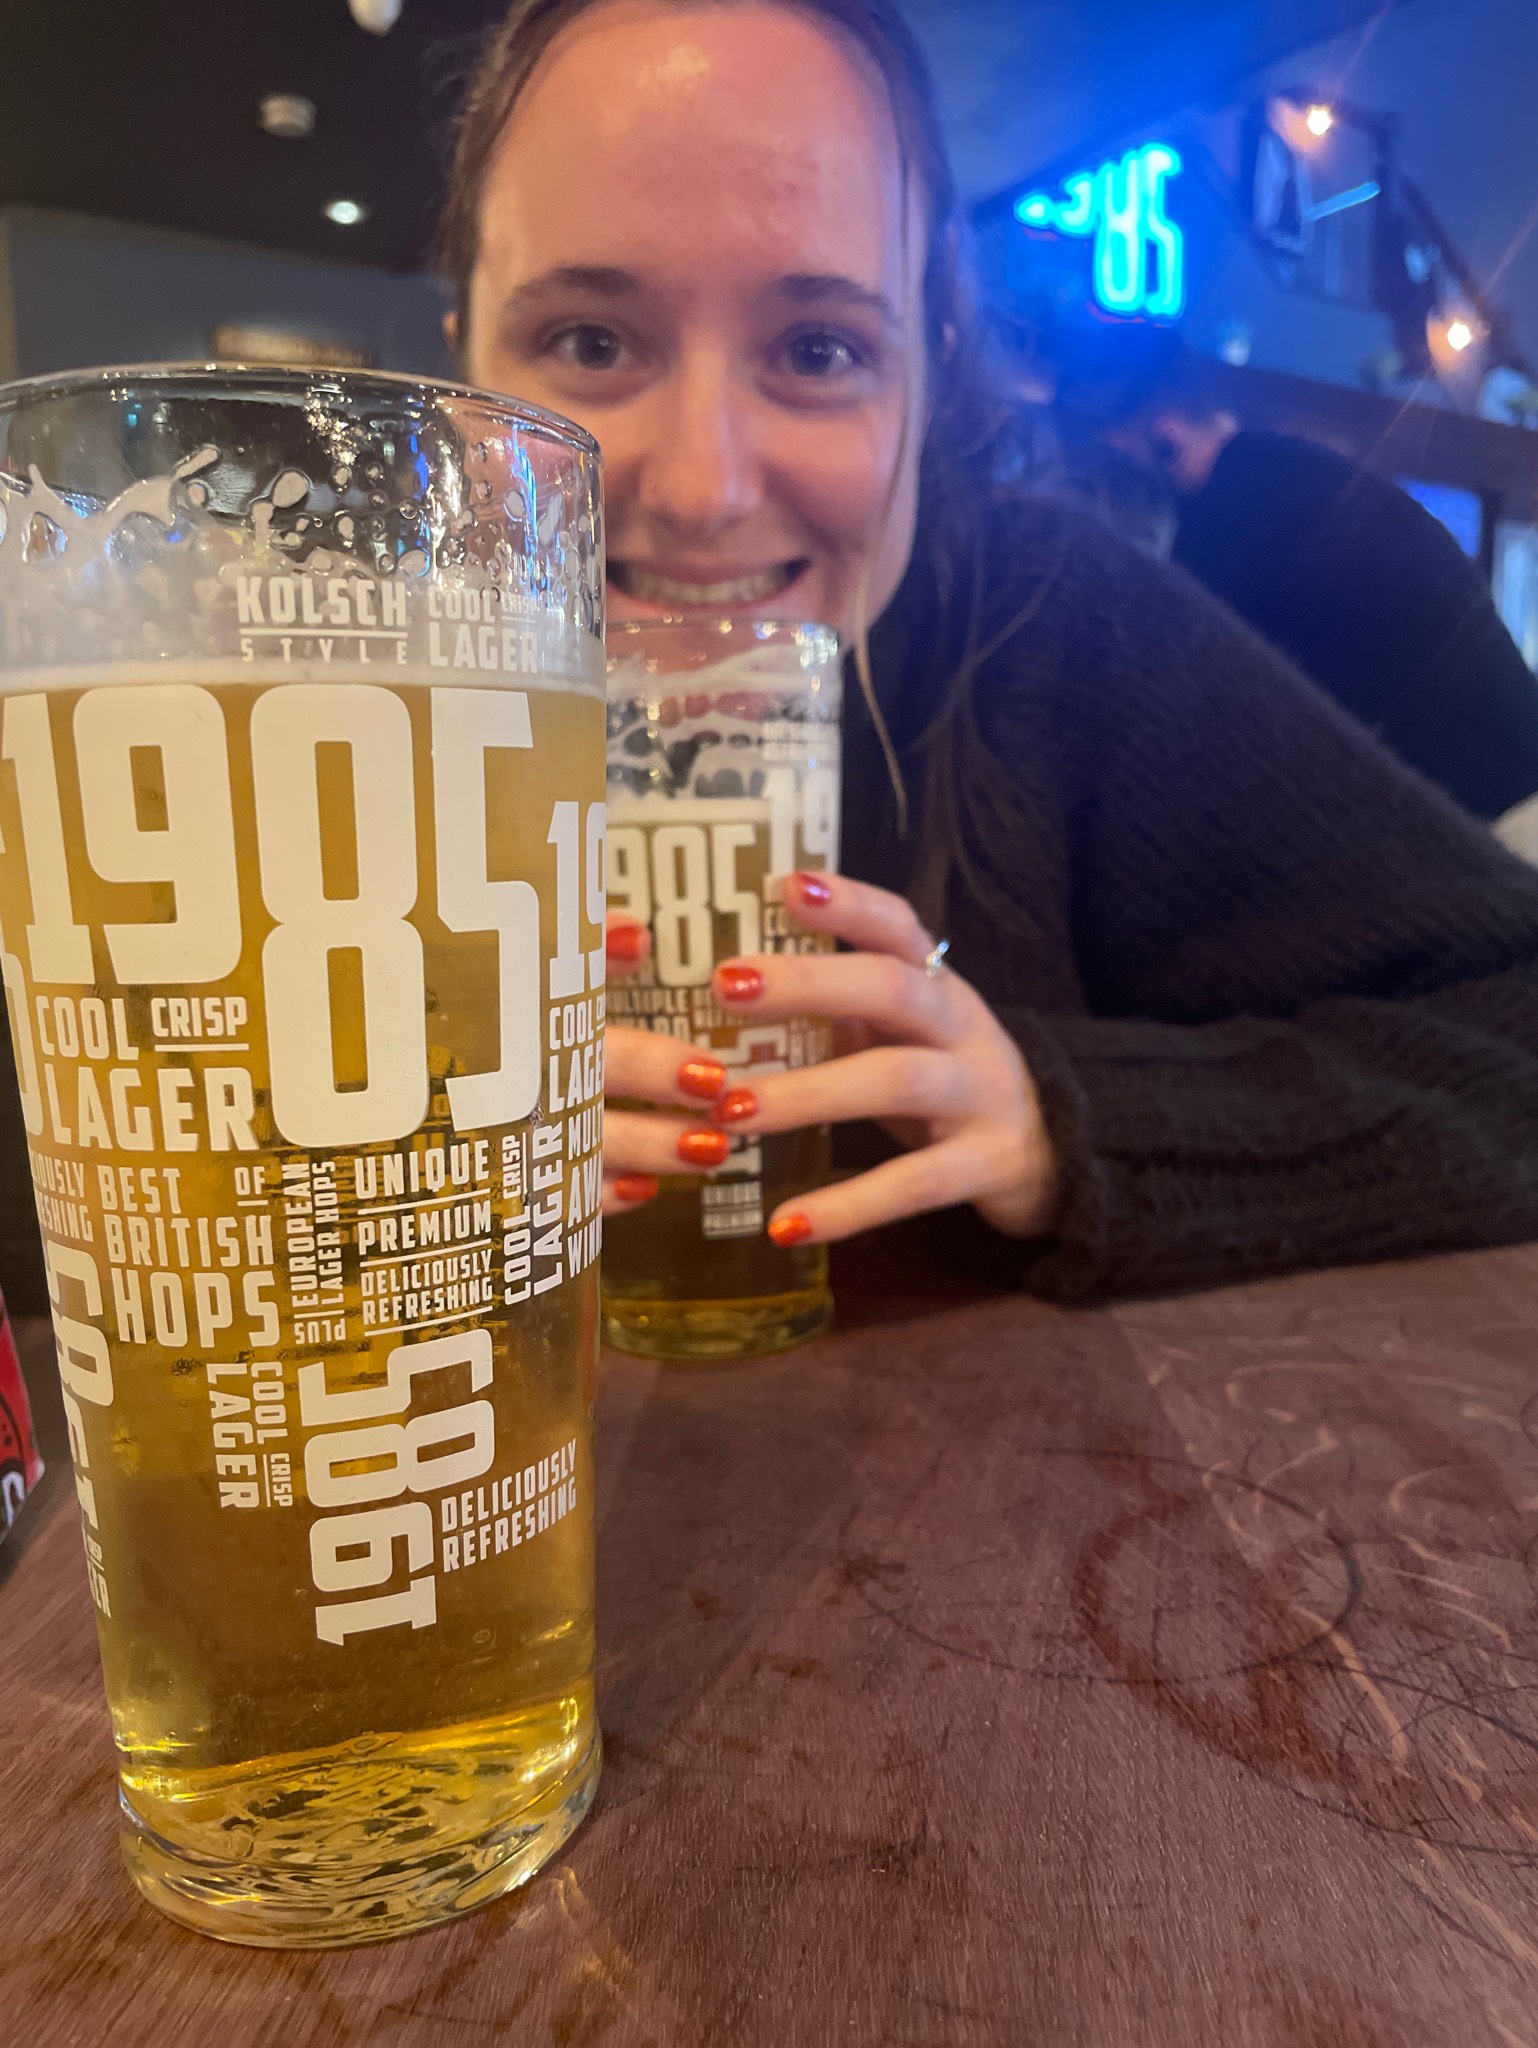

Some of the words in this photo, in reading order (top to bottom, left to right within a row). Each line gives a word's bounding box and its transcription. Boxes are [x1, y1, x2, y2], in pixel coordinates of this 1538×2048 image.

[236, 576, 407, 627] KOLSCH
[427, 584, 496, 624] COOL
[240, 638, 408, 665] STYLE
[429, 621, 539, 674] LAGER
[2, 684, 541, 1148] 1985
[606, 826, 760, 987] 985
[36, 995, 140, 1061] COOL
[151, 997, 249, 1038] CRISP
[549, 998, 594, 1051] COOL
[45, 1062, 261, 1152] LAGER
[568, 1100, 606, 1161] MULT
[32, 1152, 85, 1199] IOUSLY
[97, 1165, 182, 1215] BEST
[234, 1166, 266, 1196] OF
[311, 1161, 340, 1224] HOPS
[354, 1139, 490, 1200] UNIQUE
[502, 1134, 521, 1200] CRISP
[568, 1149, 604, 1229] AWA
[35, 1186, 94, 1243] ESHING
[282, 1163, 319, 1308] EUROPEAN
[357, 1200, 491, 1256] PREMIUM
[532, 1120, 563, 1296] LAGER
[104, 1214, 275, 1268] BRITISH
[317, 1231, 345, 1305] LAGER
[360, 1249, 493, 1297] DELICIOUSLY
[503, 1205, 532, 1306] COOL
[567, 1204, 604, 1279] WINN
[111, 1267, 280, 1348] HOPS
[294, 1318, 347, 1345] PLUS
[362, 1277, 493, 1326] REFRESHING
[206, 1362, 260, 1509] LAGER
[251, 1361, 289, 1445] COOL
[270, 1452, 294, 1507] CRISP
[298, 1328, 495, 1646] 1985
[441, 1437, 577, 1533] DELICIOUSLY
[442, 1476, 577, 1574] REFRESHING
